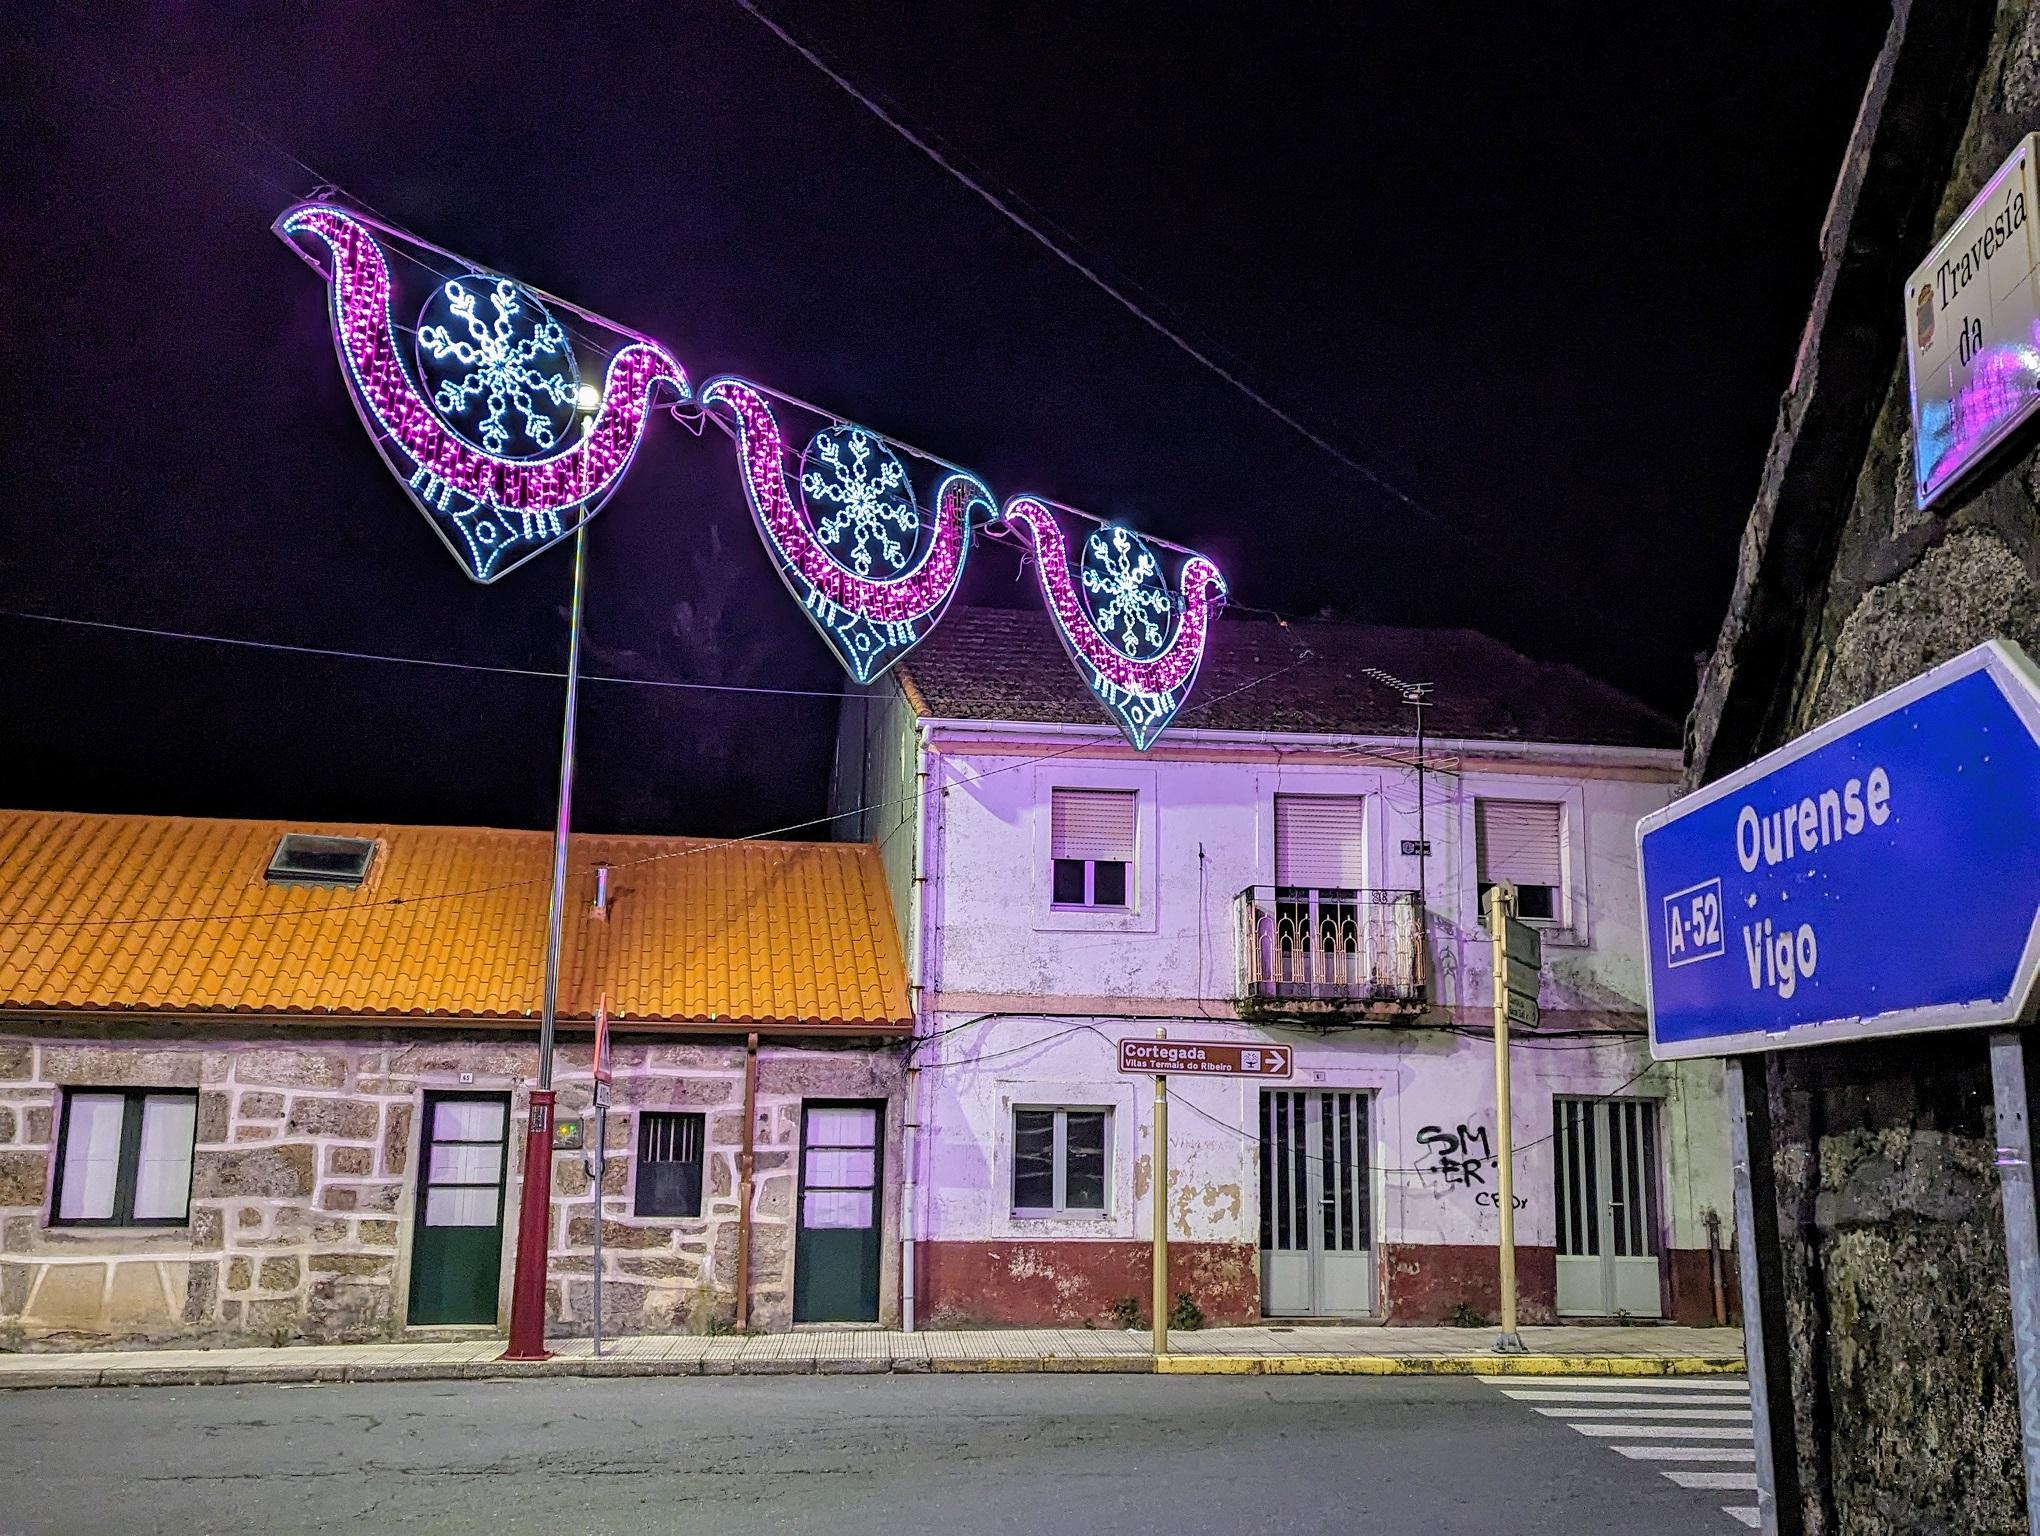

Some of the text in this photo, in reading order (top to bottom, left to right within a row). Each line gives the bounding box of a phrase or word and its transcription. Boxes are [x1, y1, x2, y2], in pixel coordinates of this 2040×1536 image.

[1936, 188, 2026, 311] Travesía
[1959, 315, 1983, 367] da
[1737, 767, 1890, 872] Ourense
[1671, 893, 1720, 954] A-52
[1743, 918, 1817, 998] Vigo
[1125, 1044, 1206, 1061] Cortegada
[1125, 1059, 1232, 1071] Vilas Termais do Ribeiro
